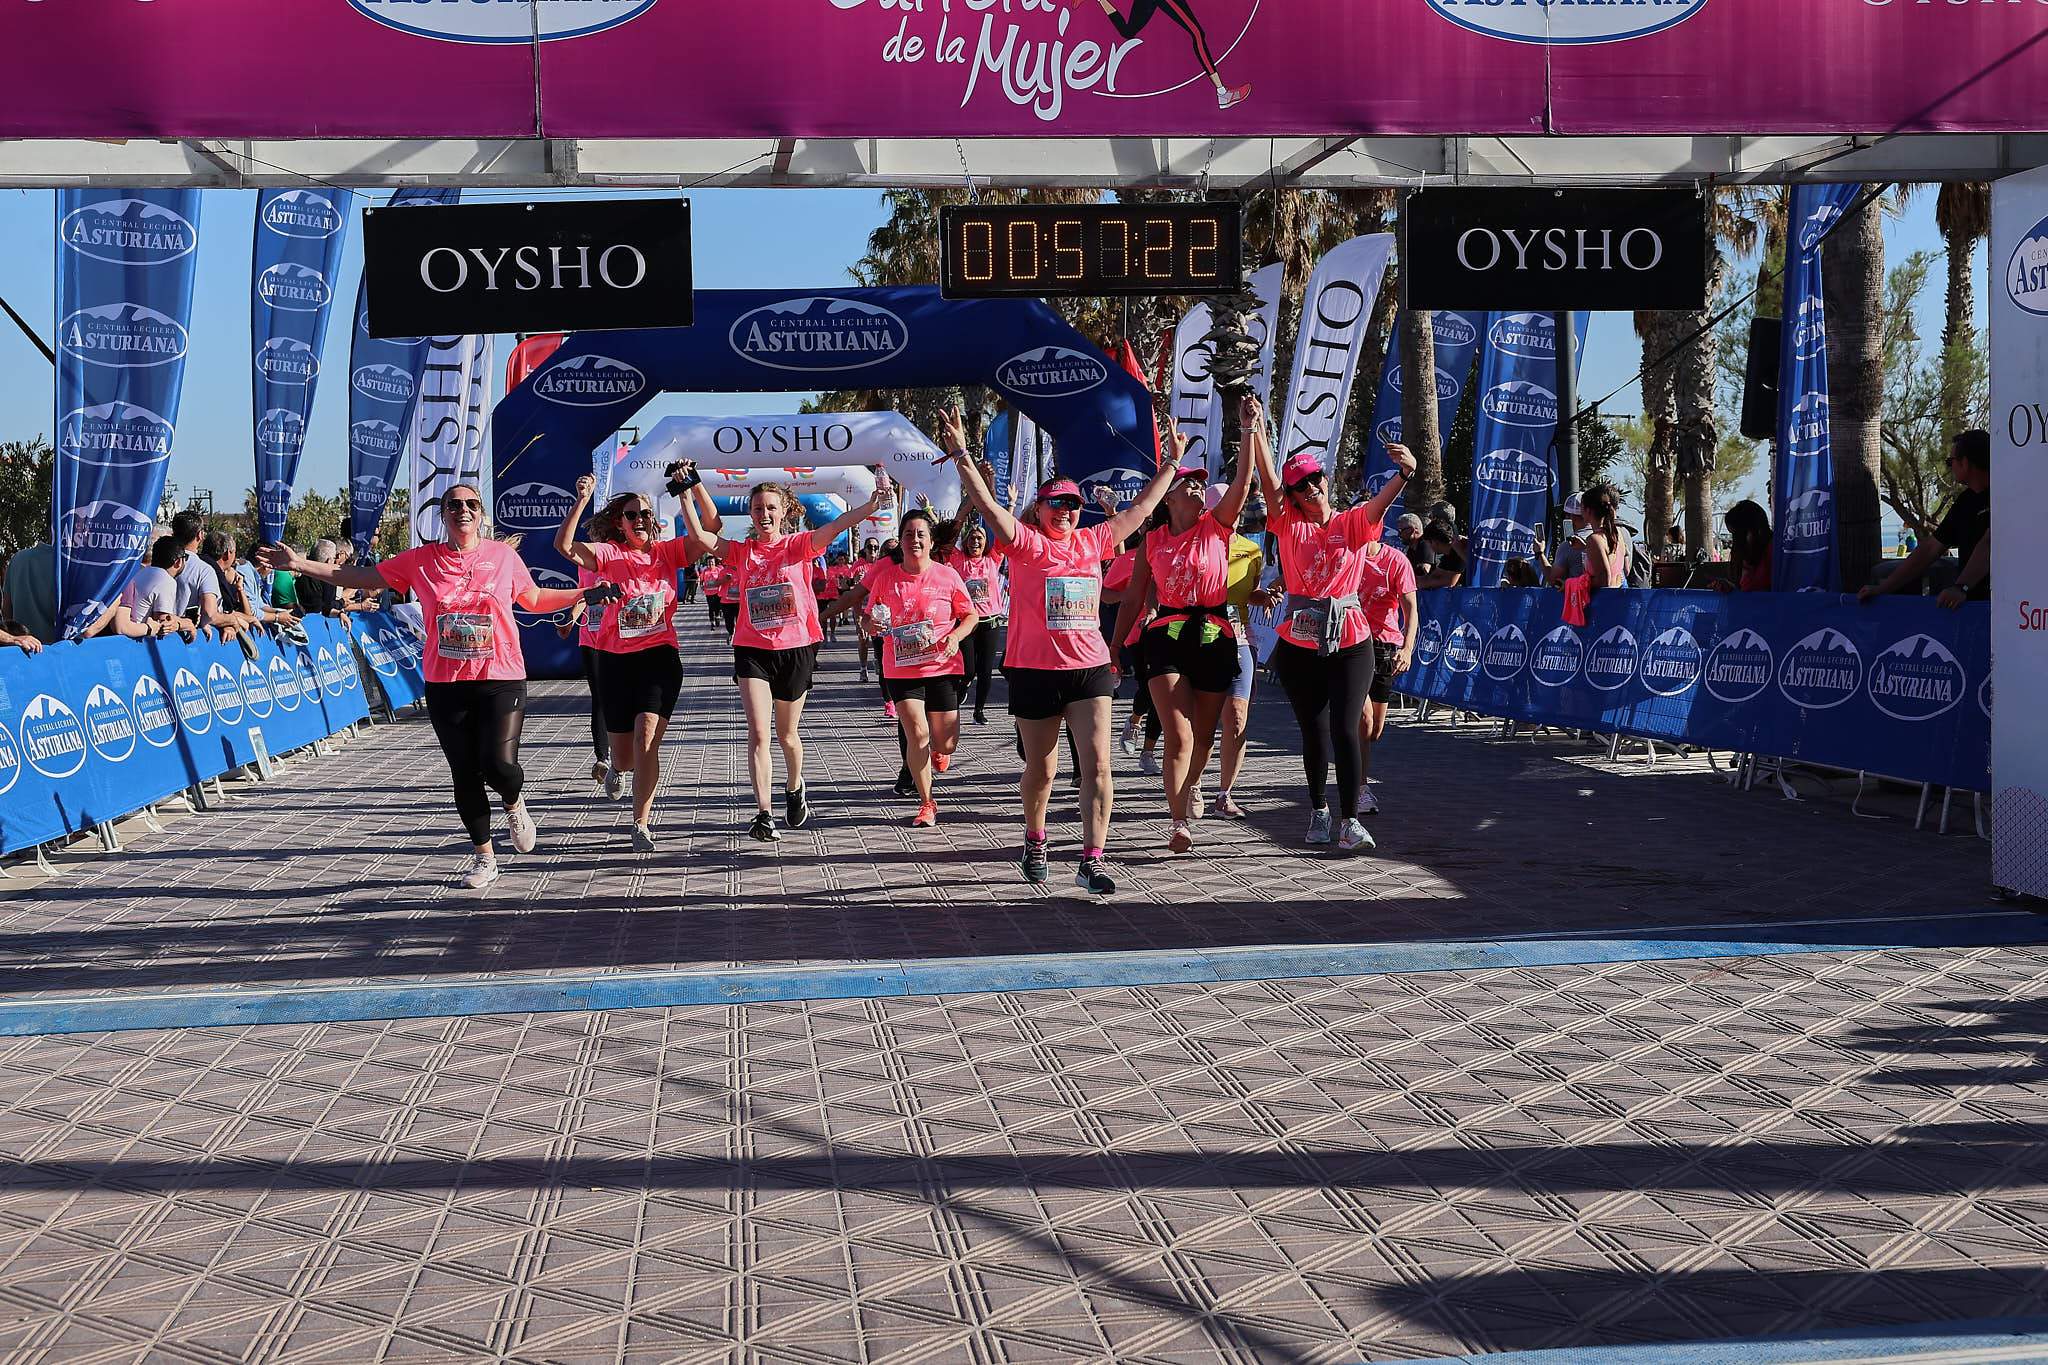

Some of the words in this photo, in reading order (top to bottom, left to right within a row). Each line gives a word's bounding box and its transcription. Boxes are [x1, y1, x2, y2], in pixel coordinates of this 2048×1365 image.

[882, 15, 925, 63] de
[935, 13, 966, 63] la
[960, 8, 1144, 121] Mujer
[70, 218, 186, 250] ASTURIANA
[94, 218, 139, 229] CENTRAL
[143, 223, 182, 231] LECHERA
[963, 219, 1218, 280] 00:57:22
[1457, 227, 1663, 272] OYSHO
[420, 245, 647, 293] OYSHO
[88, 322, 130, 332] CENTRAL
[133, 326, 176, 334] LECHERA
[743, 320, 896, 352] ASTURIANA
[770, 318, 827, 327] CENTRAL
[832, 318, 889, 326] LECHERA
[66, 321, 179, 354] ASTURIANA
[1494, 325, 1556, 351] ASTURIA
[1005, 367, 1101, 386] ASTURIANA
[1287, 280, 1364, 458] YSHO
[357, 373, 411, 397] ASTURIAN
[539, 374, 637, 393] ASTURIANA
[1487, 393, 1558, 420] ASTURIANA
[62, 422, 168, 454] ASTURIANA
[713, 423, 853, 454] OYSHO
[893, 452, 935, 462] OYSHO
[1479, 462, 1548, 487] ASTURIANA
[1485, 643, 1523, 667] ASTURIANA
[1532, 646, 1578, 671] ASTURIANA
[1588, 649, 1633, 674] ASTURIANA
[1643, 650, 1695, 679] ASTURIANA
[1800, 655, 1826, 664] CENTRAL
[1828, 657, 1856, 666] LECHERA
[1889, 662, 1919, 672] CENTRAL
[1921, 663, 1953, 675] LECHERA
[1707, 654, 1766, 684] ASTURIANA
[1783, 656, 1854, 690] ASTURIANA
[1872, 662, 1953, 702] ASTURIANA
[32, 723, 54, 735] CENTRAL
[55, 719, 76, 730] LECHERA
[89, 715, 134, 746] ASTURIANA
[137, 705, 176, 732] ASTURIANA
[26, 729, 84, 762] ASTURIANA
